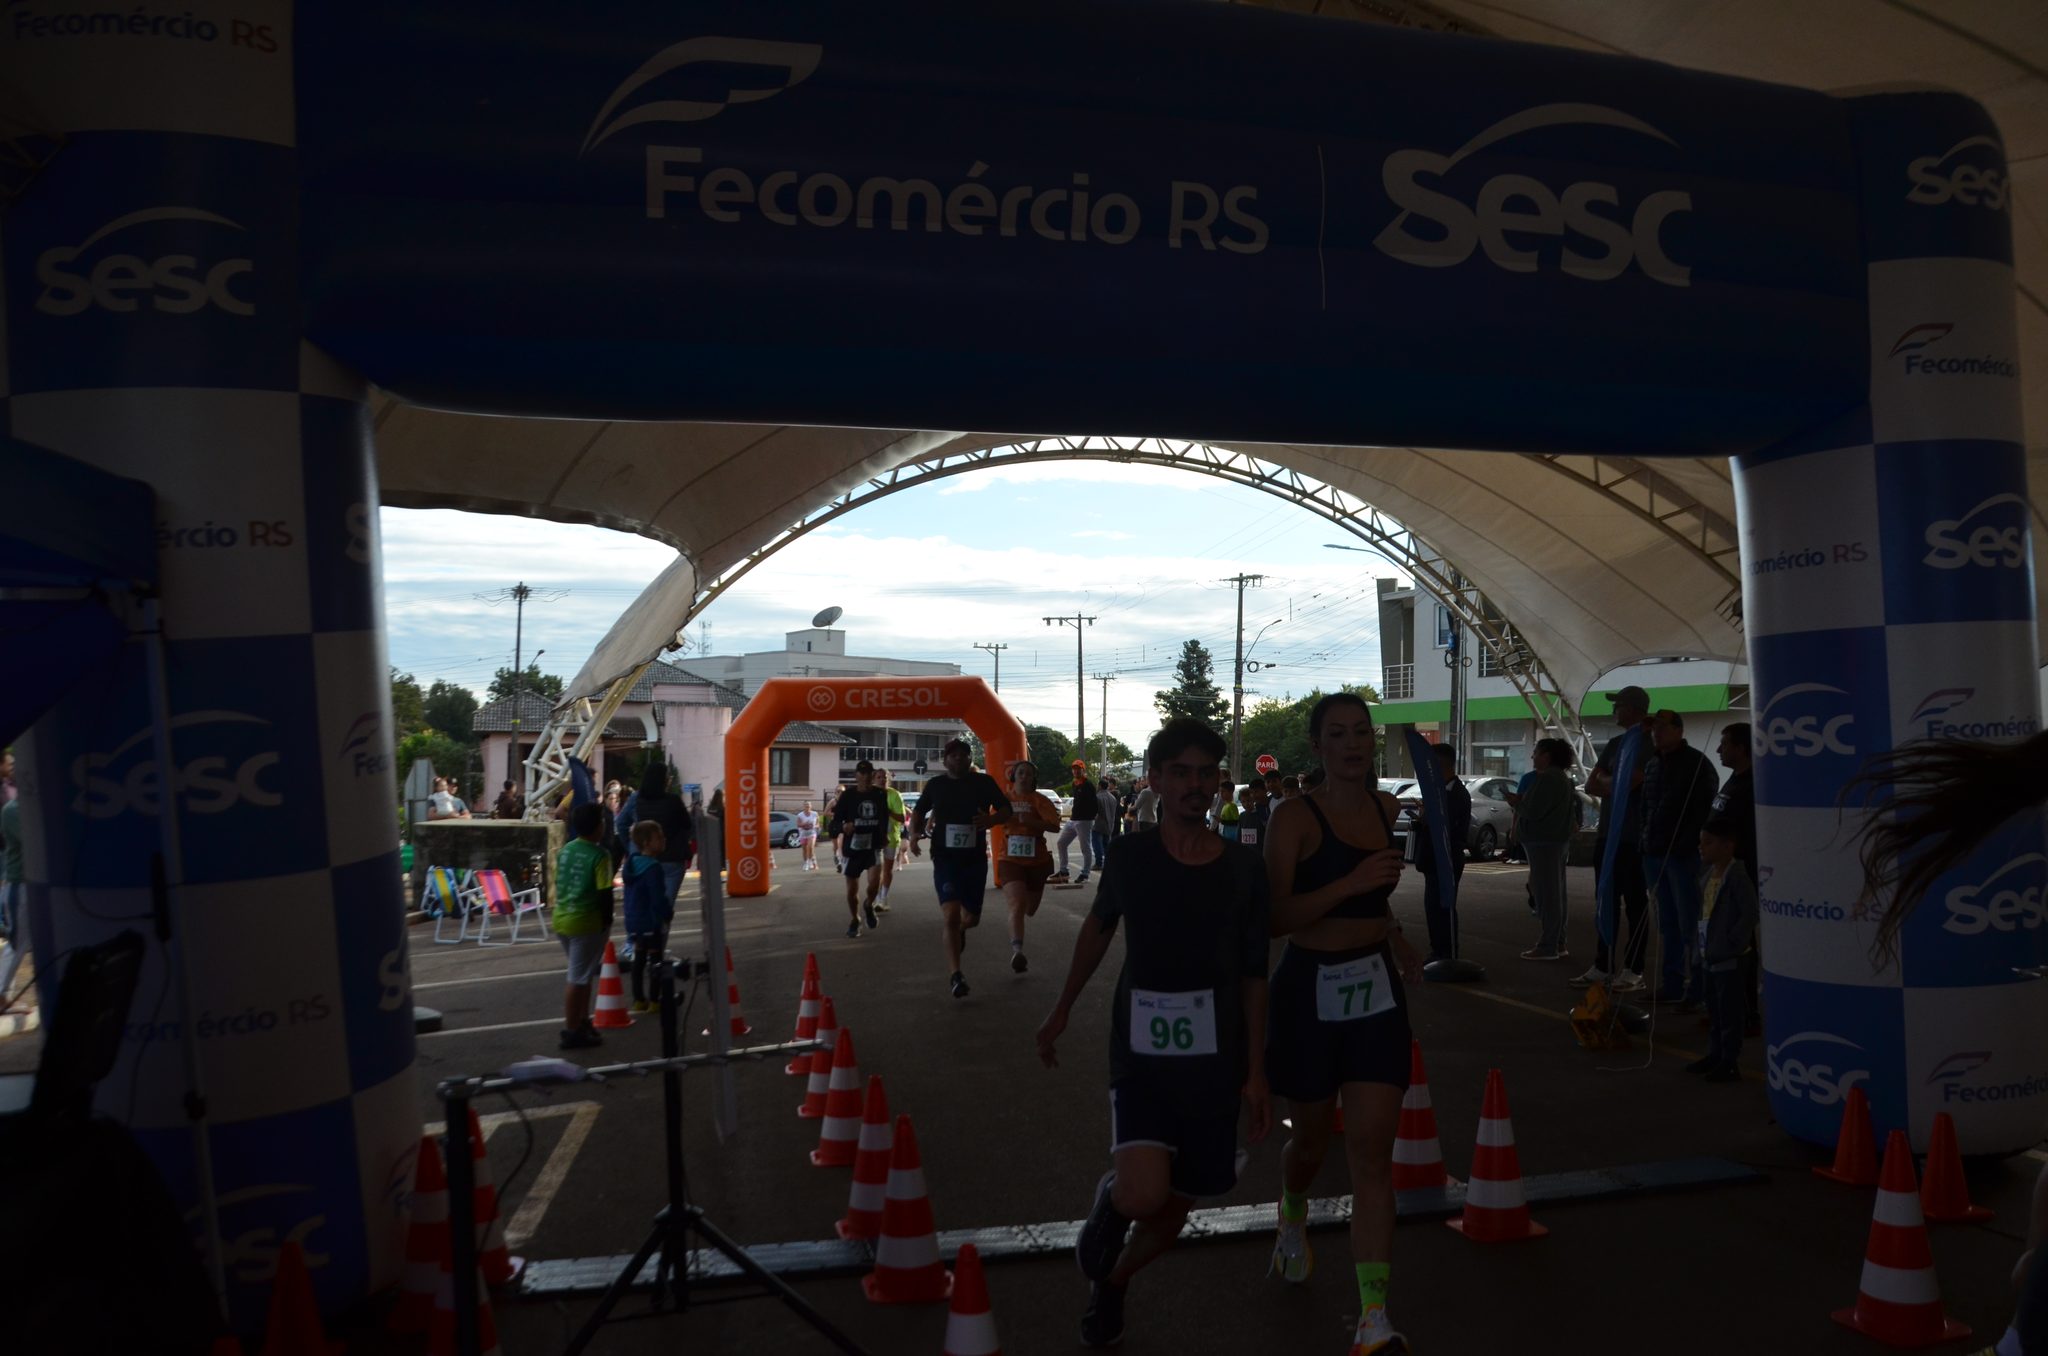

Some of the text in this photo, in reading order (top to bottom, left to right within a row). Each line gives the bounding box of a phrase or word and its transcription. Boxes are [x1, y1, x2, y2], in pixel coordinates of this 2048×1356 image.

[14, 6, 279, 54] Fecomércio RS
[645, 144, 1270, 255] Fecomércio RS
[154, 520, 293, 549] ércio RS
[1833, 542, 1868, 564] RS
[844, 687, 949, 708] CRESOL
[1257, 761, 1276, 769] PARE
[738, 762, 758, 850] CRESOL
[953, 833, 970, 847] 57
[1011, 843, 1032, 855] 218
[1760, 898, 1845, 921] ecomércio
[1941, 885, 2048, 935] Ses
[288, 994, 330, 1025] RS
[1338, 980, 1373, 1015] 77
[1150, 1015, 1194, 1050] 96
